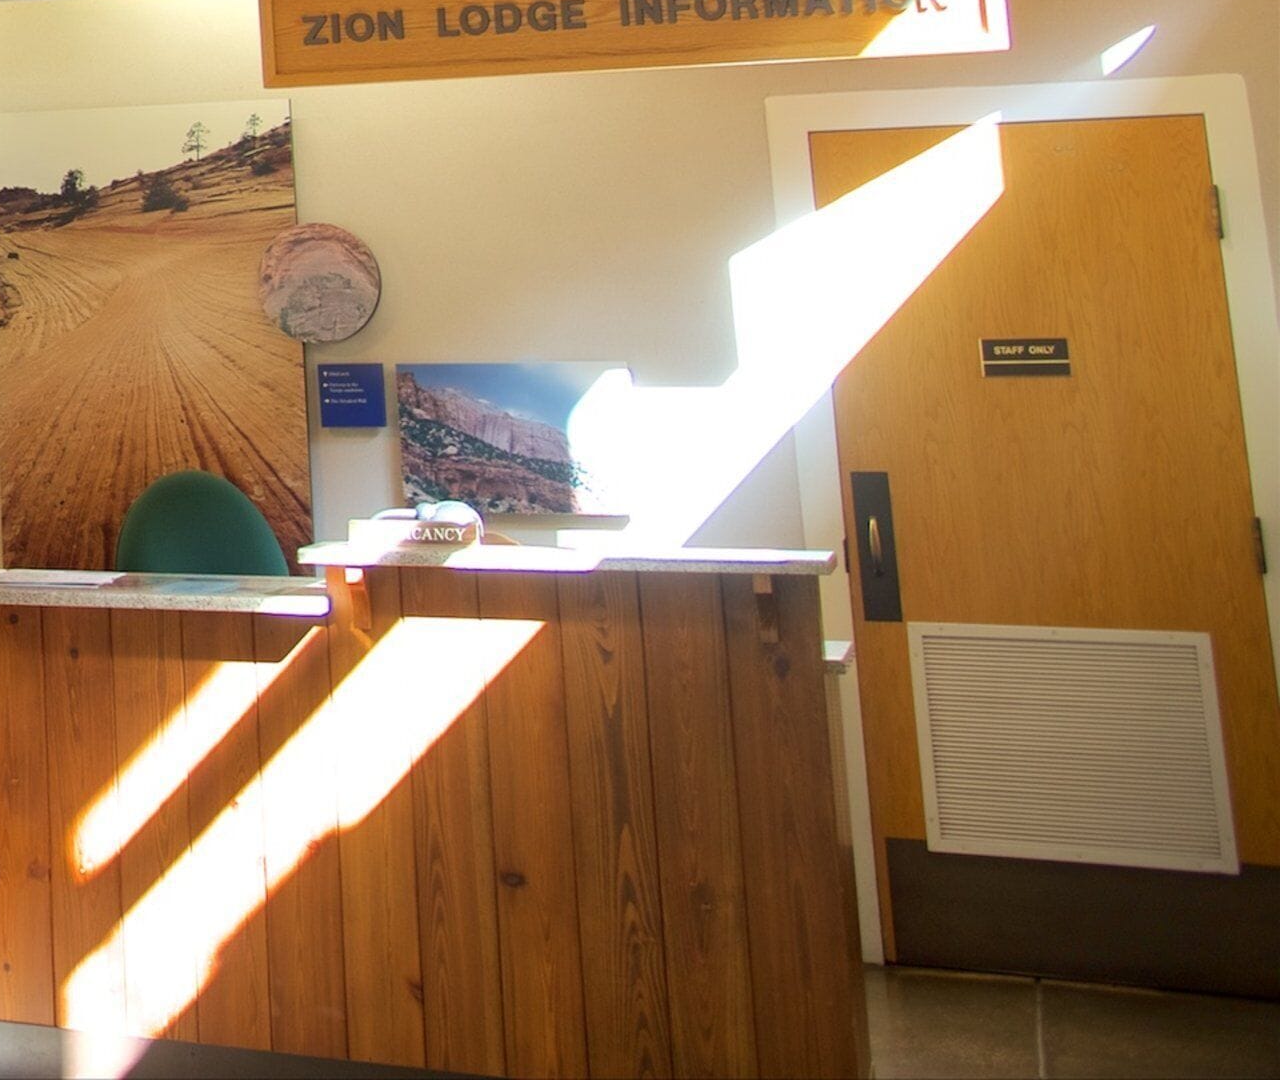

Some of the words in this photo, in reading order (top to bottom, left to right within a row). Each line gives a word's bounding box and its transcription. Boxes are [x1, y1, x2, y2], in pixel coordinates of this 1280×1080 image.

[302, 9, 405, 46] ZION
[993, 345, 1024, 355] STAFF
[1028, 345, 1055, 354] ONLY
[409, 526, 466, 541] CANCY
